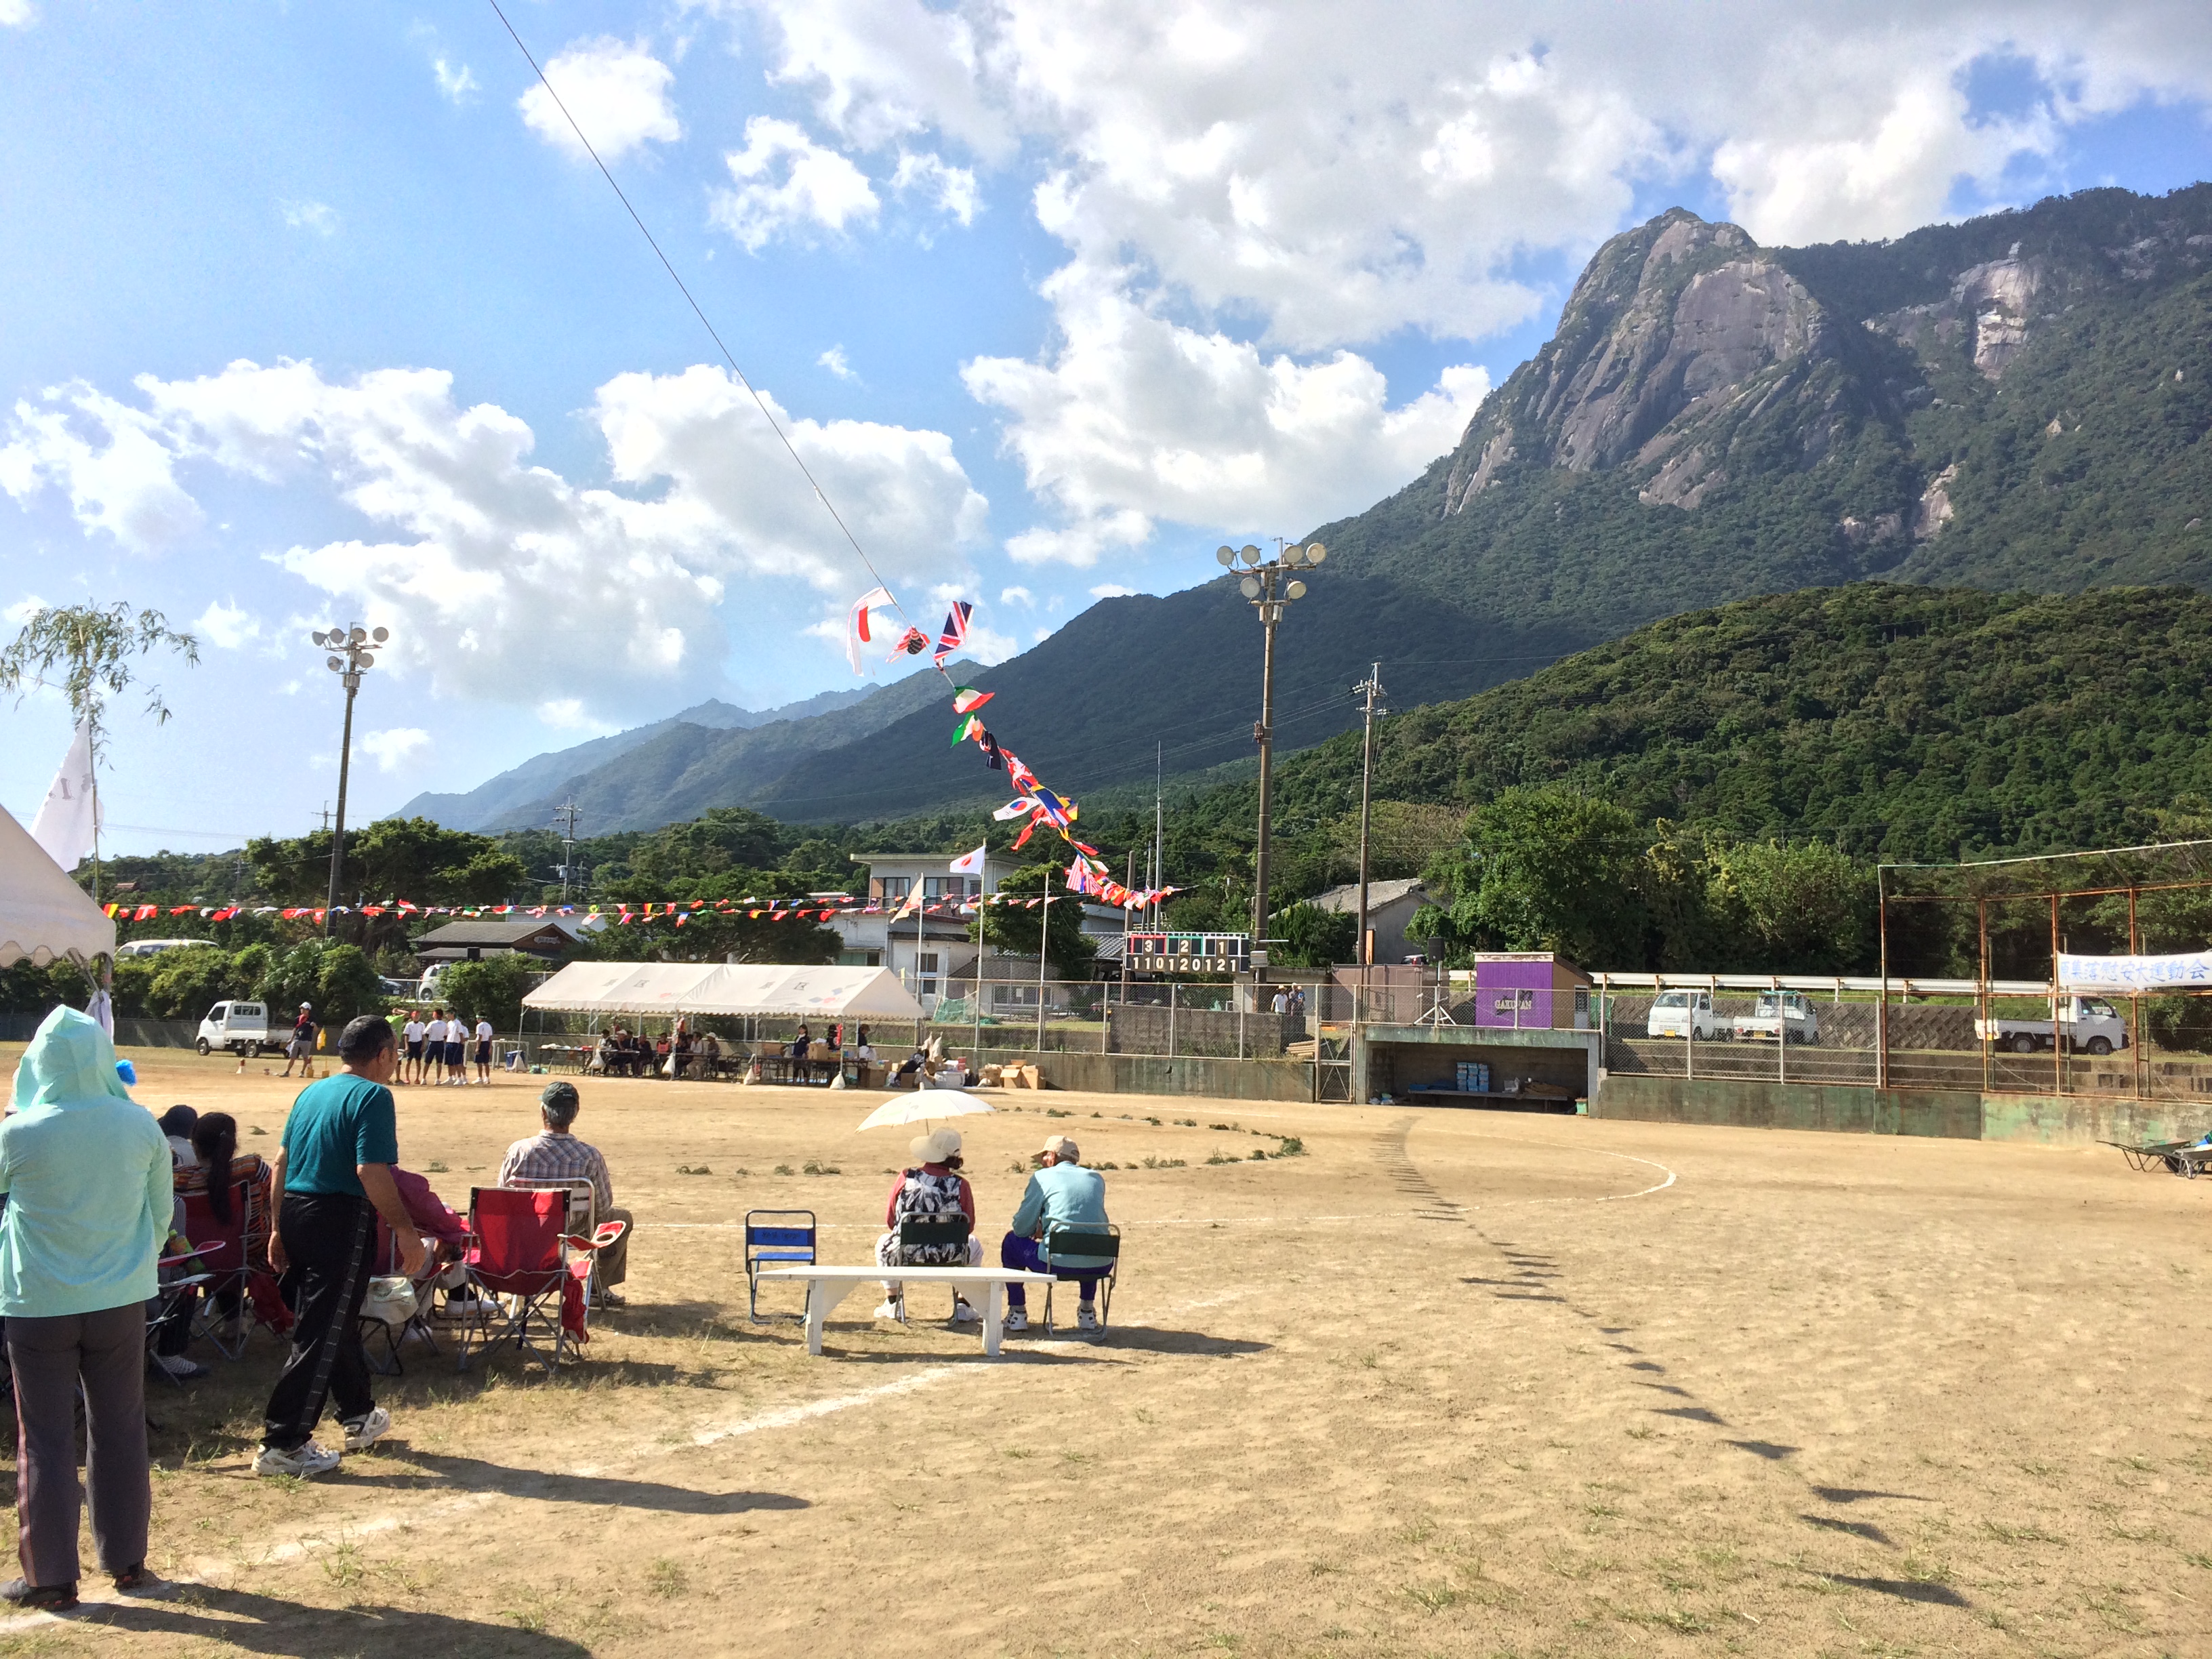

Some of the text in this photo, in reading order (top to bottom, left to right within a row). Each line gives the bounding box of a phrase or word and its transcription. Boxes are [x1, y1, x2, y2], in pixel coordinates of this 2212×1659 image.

[1145, 939, 1225, 954] 3 2 1
